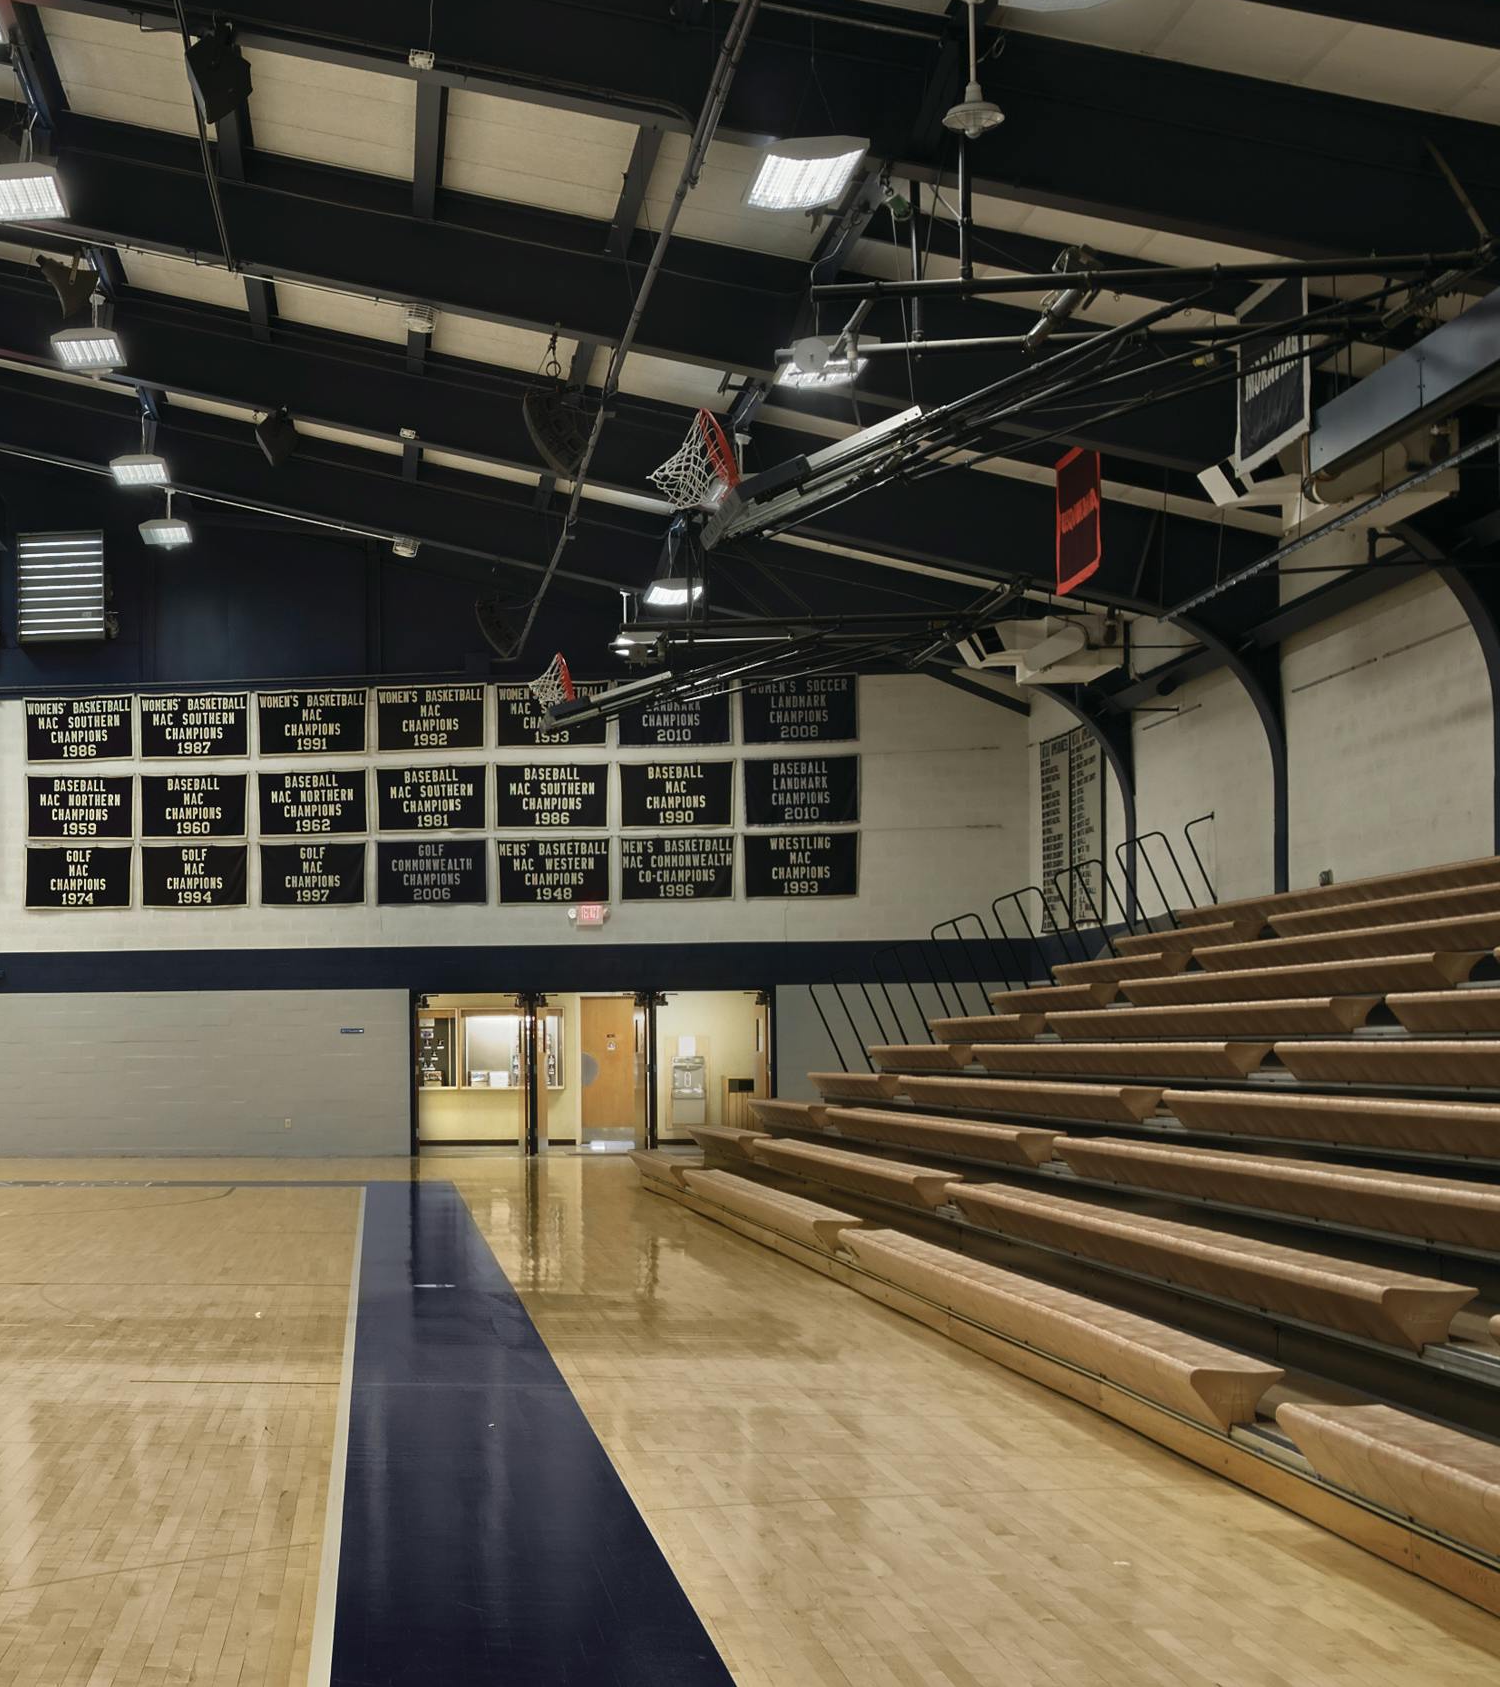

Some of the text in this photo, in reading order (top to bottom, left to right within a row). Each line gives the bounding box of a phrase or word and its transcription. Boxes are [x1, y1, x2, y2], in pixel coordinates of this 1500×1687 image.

[807, 678, 848, 692] SOCCER
[379, 688, 482, 704] WOMEN'S BASKETBALL
[771, 695, 826, 708] LANDMARK
[73, 700, 130, 713] BASKETBALL
[420, 706, 440, 717] MAC
[38, 715, 120, 729] MAC SOUTHERN
[770, 710, 828, 723] CHAMPIONS
[403, 720, 458, 732] CHAMPIONS
[781, 726, 818, 738] 2008
[51, 730, 108, 743] CHAMPIONS
[414, 734, 447, 746] 1992
[63, 744, 96, 757] 1986
[404, 770, 458, 784] BASEBALL
[648, 766, 703, 779] BASEBALL
[54, 780, 106, 792] BASEBALL
[390, 784, 473, 798] MAC SOUTHERN
[666, 782, 686, 793] MAC
[40, 794, 120, 806] MAC NORTHERN
[403, 799, 461, 812] CHAMPIONS
[647, 796, 706, 809] CHAMPIONS
[52, 809, 108, 821] CHAMPIONS
[418, 814, 448, 827] 1981
[659, 811, 694, 823] 1990
[63, 823, 96, 835] 1959
[500, 843, 606, 856] MENS' BASKETBALL
[623, 839, 732, 854] MEN'S BASKETBALL
[770, 837, 830, 850] WRESTLING
[66, 850, 92, 862] GOLF
[623, 853, 732, 868] MAC COMMONWEALTH
[790, 852, 810, 864] MAC
[69, 864, 88, 876] MAC
[513, 857, 594, 871] MAC WESTERN
[525, 873, 583, 885] CHAMPIONS
[639, 869, 715, 882] CO-CHAMPIONS
[772, 867, 830, 879] CHAMPIONS
[50, 878, 106, 891] CHAMPIONS
[659, 884, 694, 896] 1996
[784, 882, 818, 894] 1993
[62, 893, 93, 904] 1974
[536, 888, 572, 900] 1948
